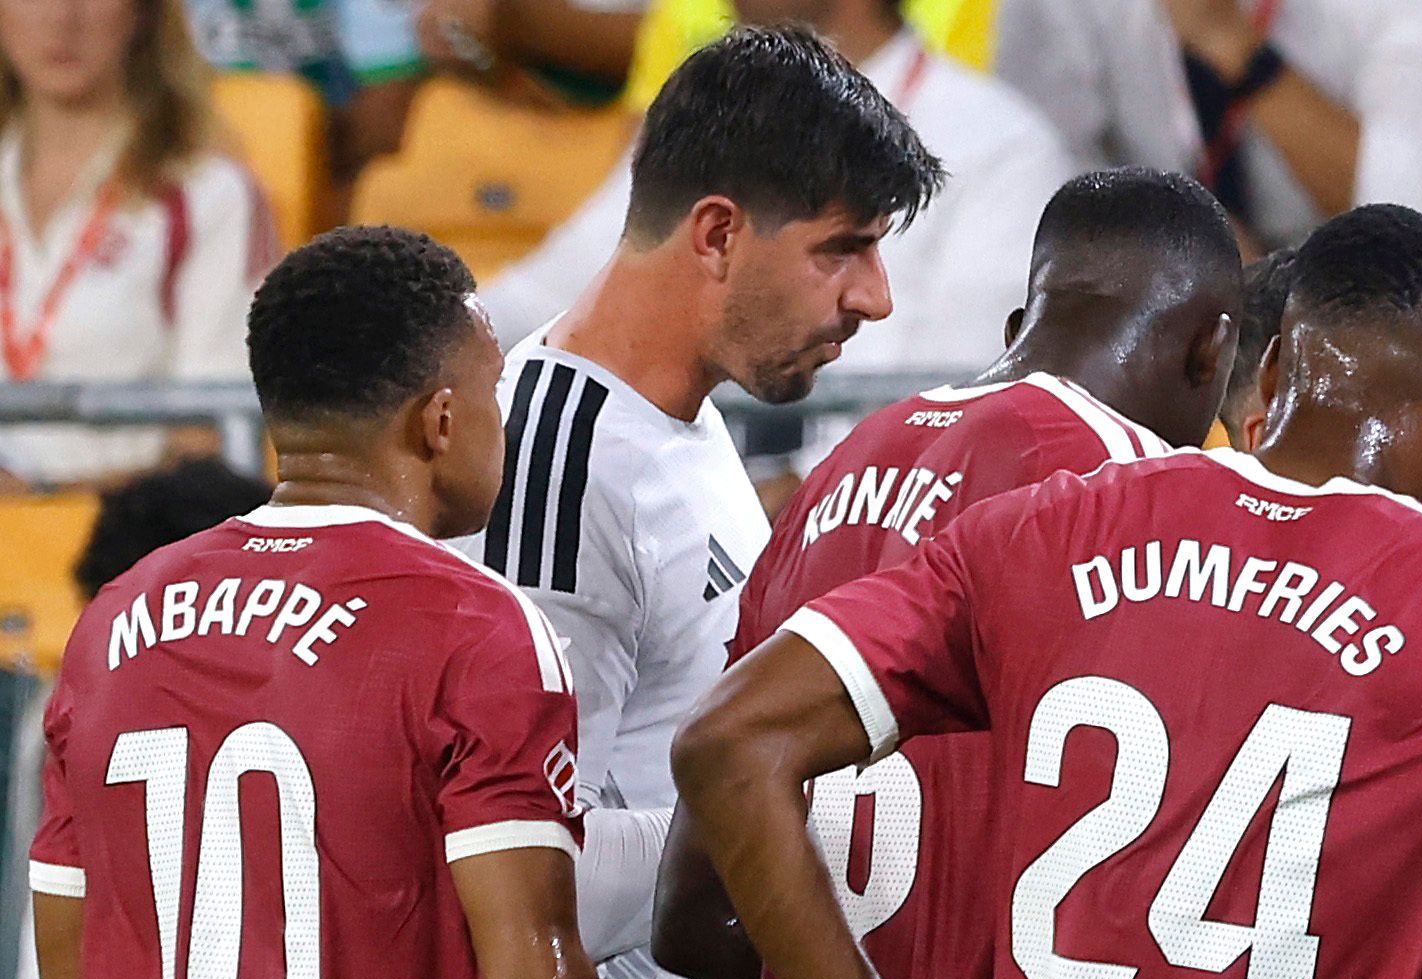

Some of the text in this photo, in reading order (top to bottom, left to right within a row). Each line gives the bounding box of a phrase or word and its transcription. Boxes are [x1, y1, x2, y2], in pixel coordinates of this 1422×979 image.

[905, 410, 964, 428] RMCF
[802, 466, 964, 552] KONATÉ
[1235, 493, 1314, 521] RMCF
[242, 537, 314, 553] RMCF
[107, 578, 368, 672] MBAPPÉ
[1071, 539, 1406, 677] DUMFRIES
